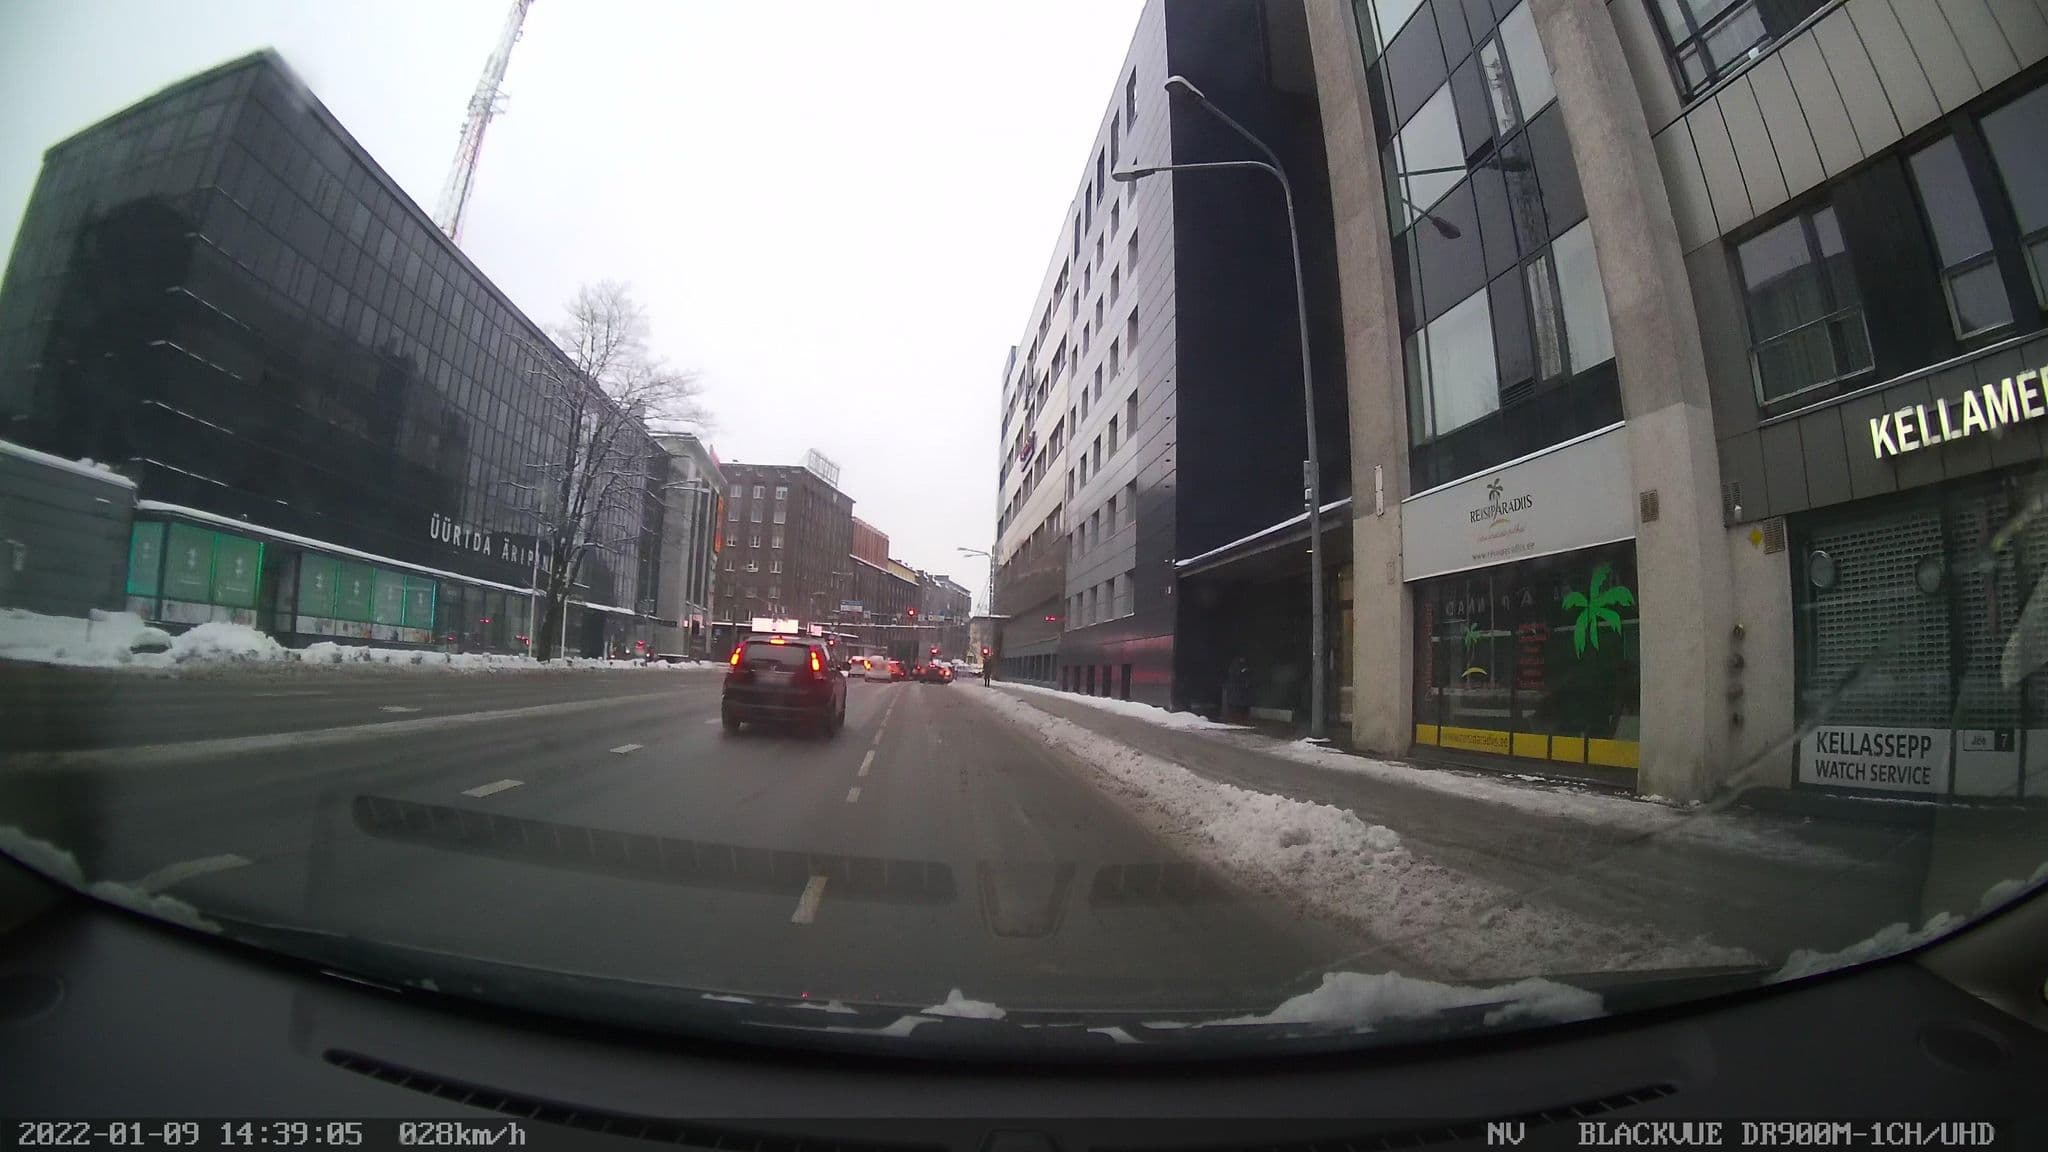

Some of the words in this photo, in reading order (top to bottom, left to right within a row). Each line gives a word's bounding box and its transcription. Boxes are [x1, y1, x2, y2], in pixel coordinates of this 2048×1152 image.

[1469, 494, 1533, 524] REISIPARADIIS
[430, 512, 491, 556] ÜÜRIDA
[1816, 731, 1932, 759] KELLASSEPP
[2000, 733, 2009, 748] 7
[1815, 760, 1866, 781] WATCH
[1870, 764, 1931, 785] SERVICE
